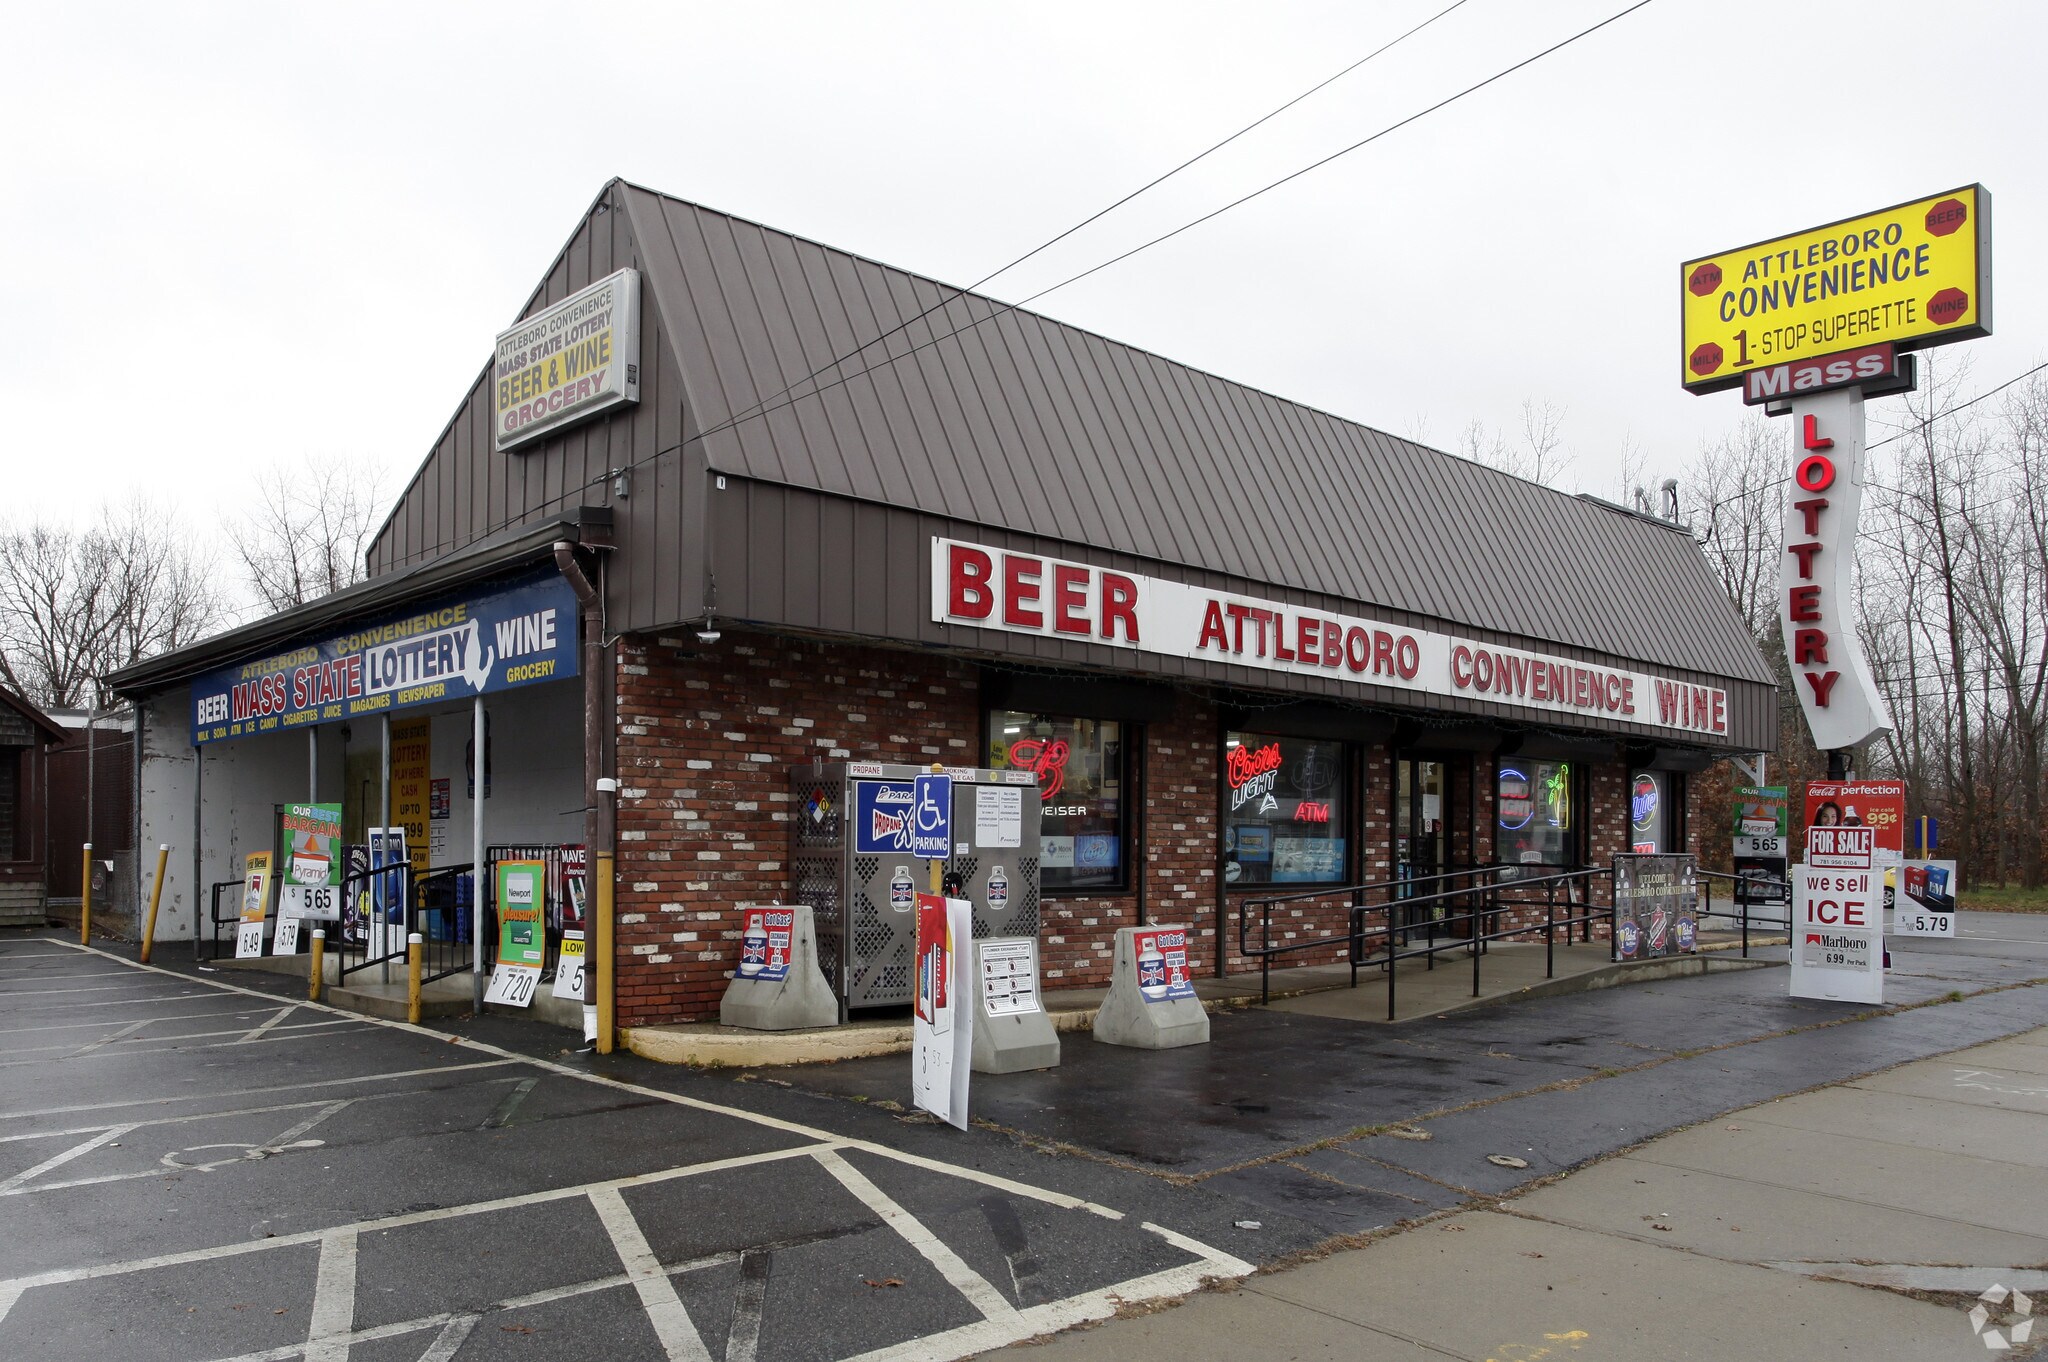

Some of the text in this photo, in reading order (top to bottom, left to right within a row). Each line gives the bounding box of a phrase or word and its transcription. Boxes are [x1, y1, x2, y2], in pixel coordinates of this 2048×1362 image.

[1927, 207, 1966, 227] BEER
[1742, 223, 1902, 284] ATTLEBORO
[1692, 271, 1721, 287] ATM
[1719, 243, 1930, 322] CONVENIENCE
[1930, 297, 1966, 316] WINE
[500, 290, 612, 358] ATTLEBORO CONVENIENCE
[1762, 323, 1807, 355] STOP
[1812, 298, 1916, 342] SUPERETTE
[498, 308, 613, 379] MASS STATE LOTTERY
[1692, 351, 1721, 368] MILK
[500, 331, 610, 411] BEER & WINE
[1751, 354, 1885, 399] Mass
[504, 369, 606, 432] GROCERY
[1788, 414, 1841, 708] LOTTERY
[241, 604, 467, 680] ATTLEBORO CONVENIENCE
[947, 544, 1727, 732] BEER ATTLEBORO CONVENIENCE WINE
[198, 608, 557, 725] BEER MASS STATE LOTTERY WINE
[507, 659, 555, 683] GROCERY
[197, 683, 445, 742] MILK SODA ATM ICE CANDY CIGARETTES JUICE MAGAZINES NEWSPAPER
[392, 744, 427, 763] LOTTERY
[852, 765, 880, 775] PROPANE
[944, 767, 968, 775] MOKING
[1227, 742, 1282, 788] Coors
[401, 784, 418, 796] CASH
[888, 792, 914, 800] PARA
[1232, 770, 1278, 811] LIGHT
[1741, 787, 1759, 795] OUR
[1841, 785, 1900, 796] perfection
[1732, 794, 1787, 809] BARGAIN
[293, 805, 340, 822] OUR BEST
[1294, 802, 1329, 823] ATM
[1866, 813, 1897, 825] 99¢
[283, 814, 342, 839] BARGAIN
[874, 812, 902, 838] PROPANE
[1743, 823, 1774, 833] Pyramid
[915, 836, 948, 851] PARKING
[1812, 831, 1870, 854] FOR SALE
[562, 850, 586, 863] MAVE
[294, 864, 327, 879] Pyramid
[564, 866, 586, 875] America
[1638, 873, 1666, 883] WELCOME
[1807, 875, 1868, 892] we sell
[291, 888, 296, 898] $
[508, 888, 532, 899] Newport
[503, 907, 541, 924] pleasure!
[765, 913, 792, 926] Got Gas?
[1808, 900, 1865, 925] ICE
[1916, 916, 1948, 931] 5.79
[243, 932, 259, 953] 6.49
[282, 925, 296, 946] 5.79
[1158, 933, 1184, 947] Got Gas?
[1821, 935, 1867, 949] Marlboro
[566, 942, 584, 953] LOW
[1826, 953, 1844, 964] 6.99
[492, 972, 499, 985] $
[560, 965, 585, 995] $ 5.
